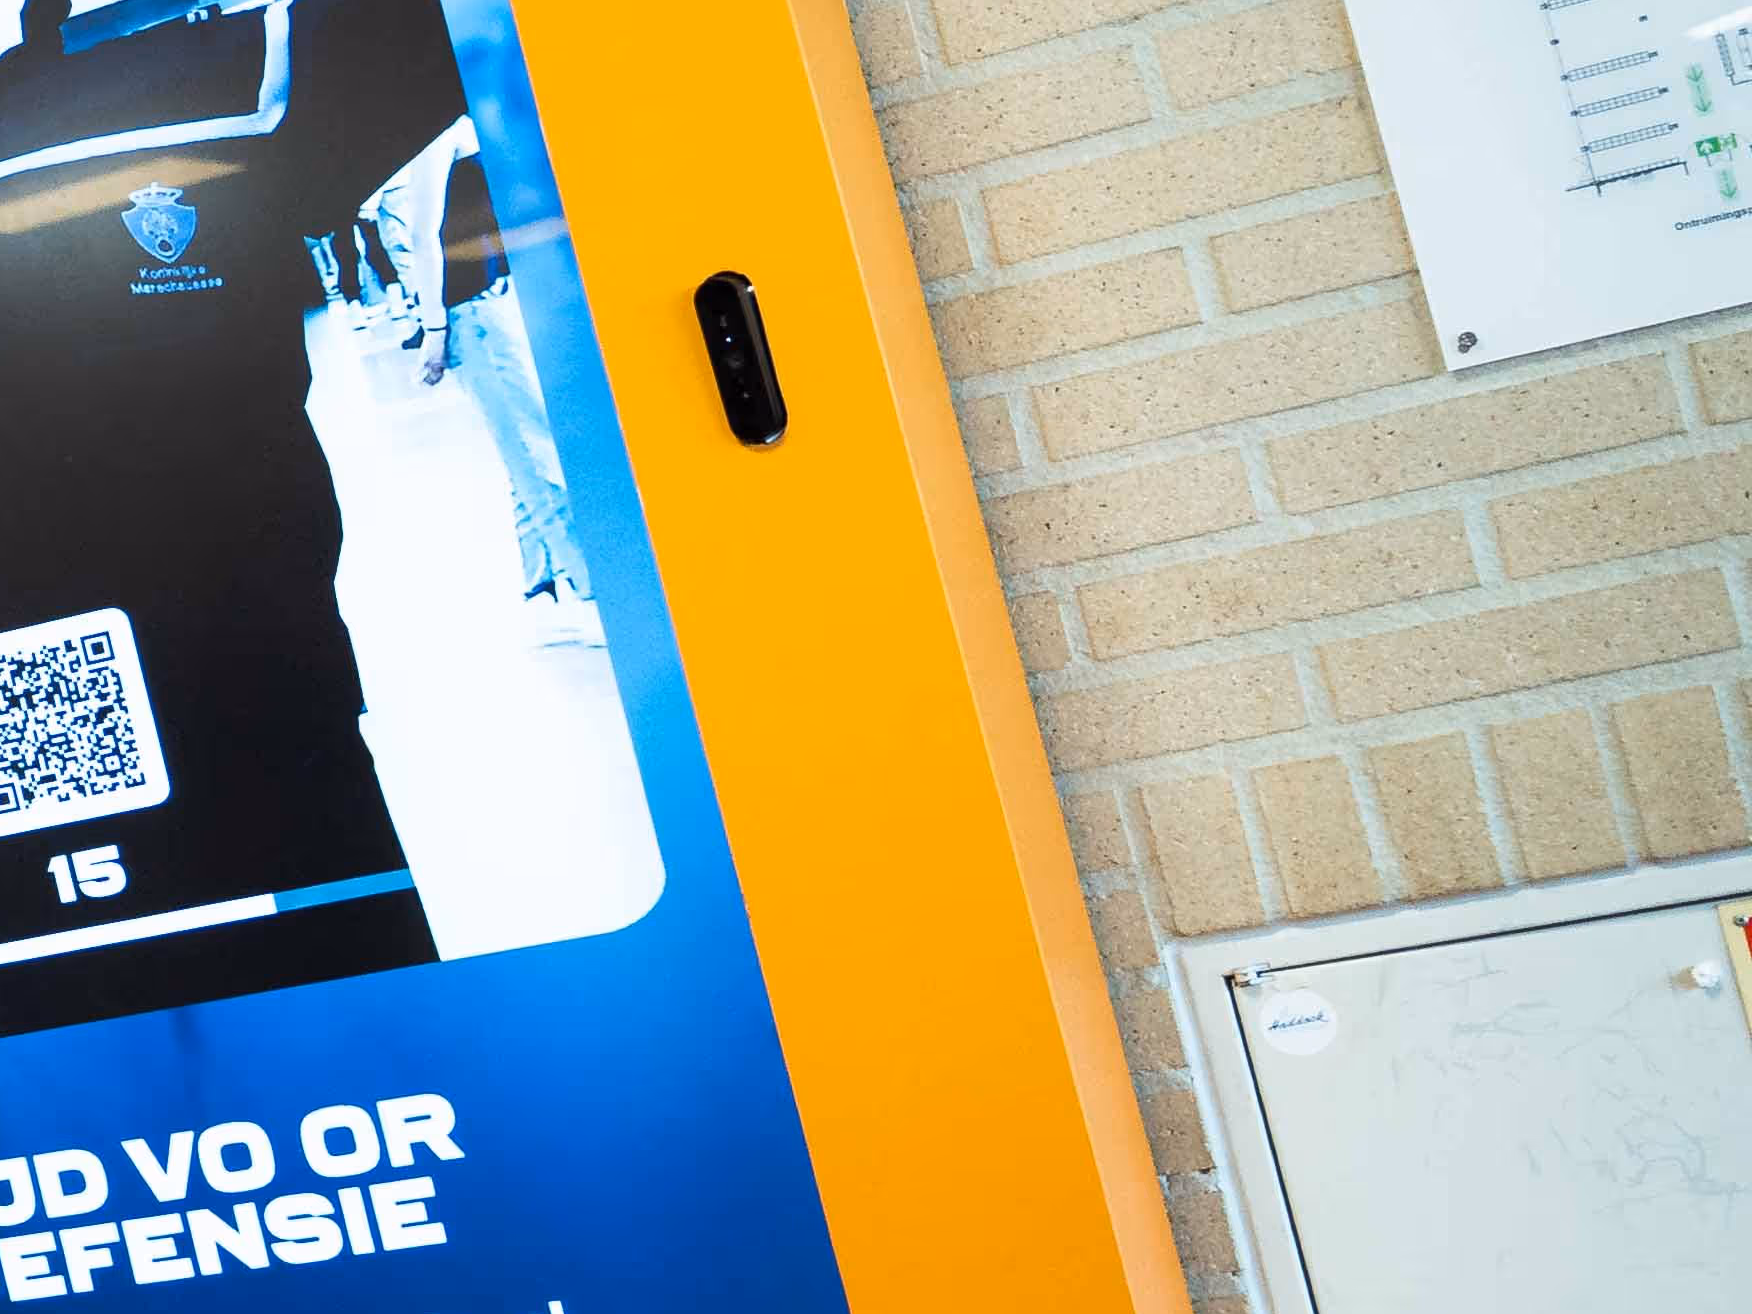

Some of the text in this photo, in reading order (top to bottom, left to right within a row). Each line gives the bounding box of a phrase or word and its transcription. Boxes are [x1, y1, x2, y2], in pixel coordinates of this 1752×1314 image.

[47, 844, 127, 904] 15
[120, 1120, 277, 1203] VO
[299, 1092, 465, 1179] OR
